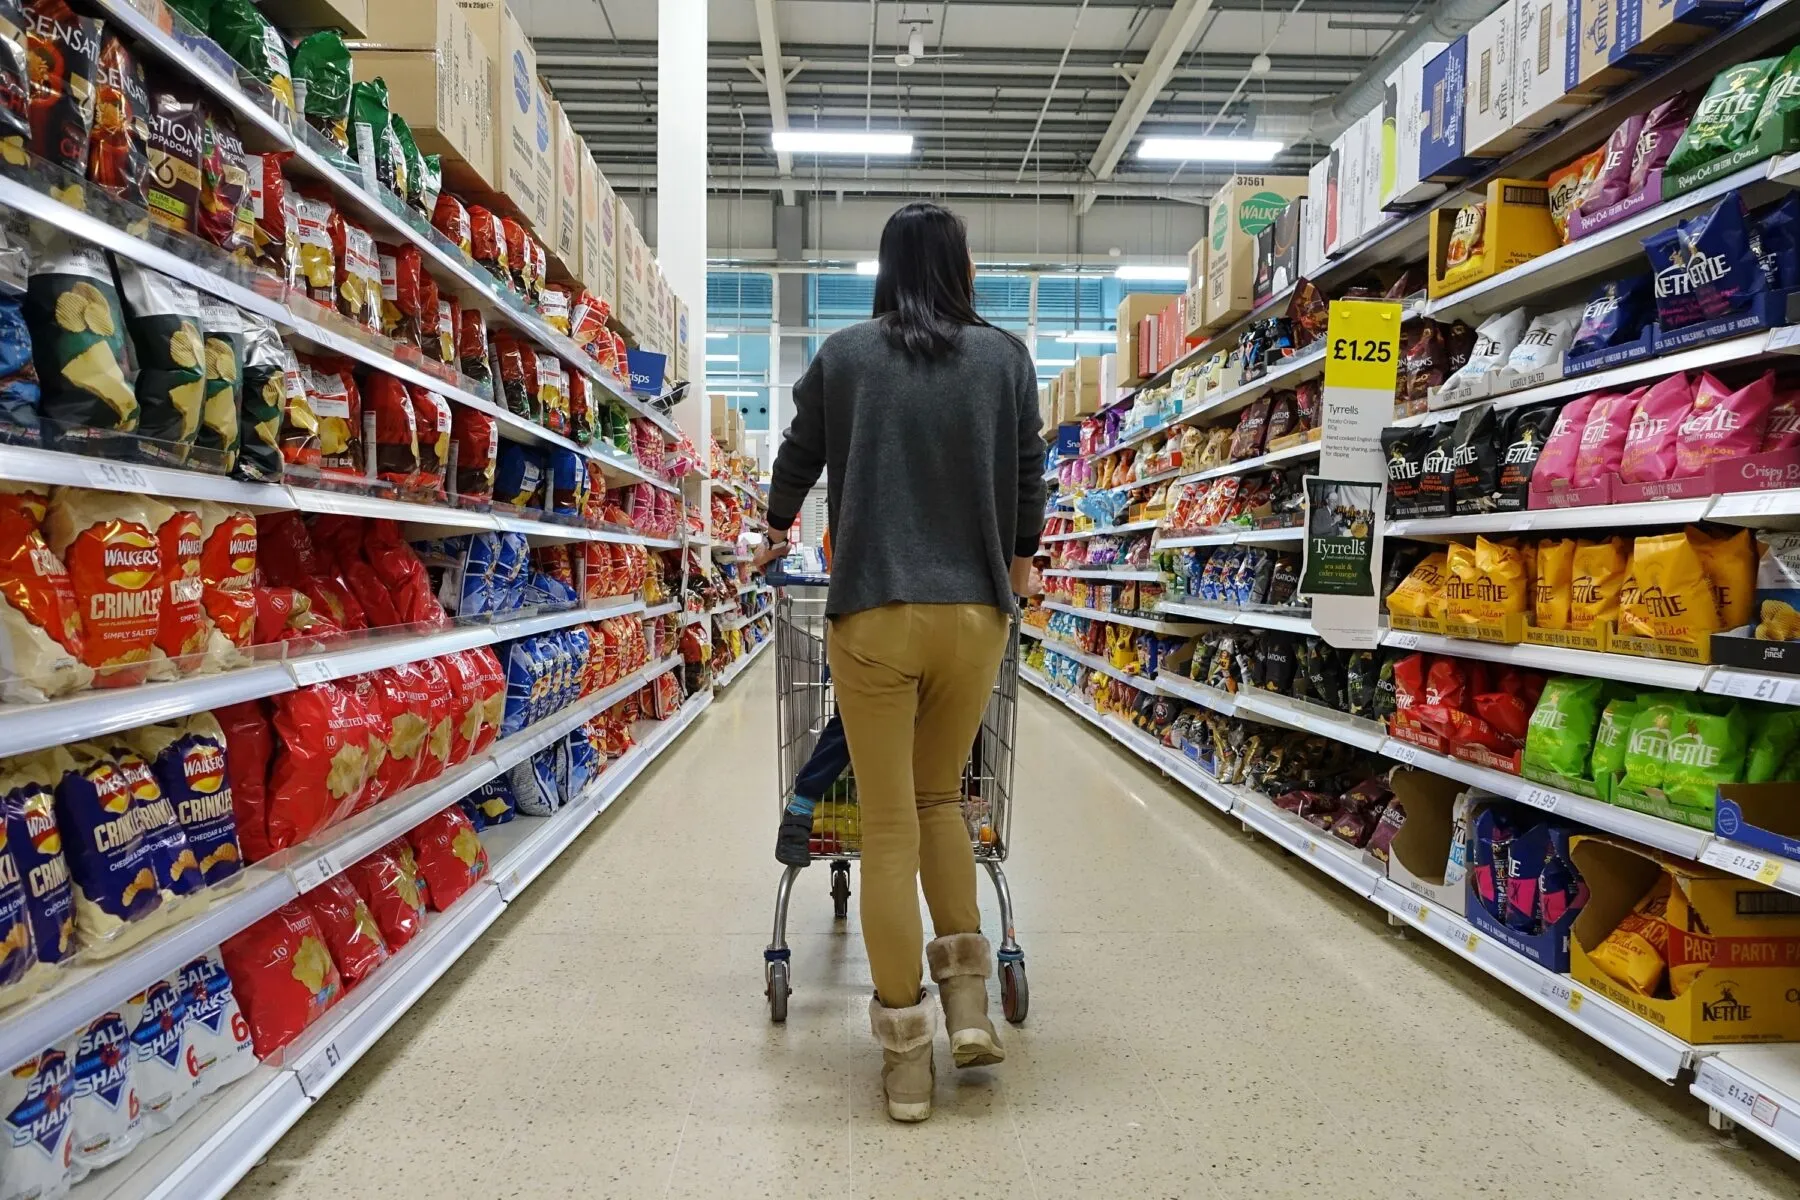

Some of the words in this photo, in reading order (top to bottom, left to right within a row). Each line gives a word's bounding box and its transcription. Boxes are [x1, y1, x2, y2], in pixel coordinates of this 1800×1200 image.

[1237, 177, 1265, 187] 37561
[1240, 205, 1280, 220] WALKE
[1333, 338, 1391, 363] £1.25
[1527, 372, 1545, 385] SALTED
[1328, 403, 1359, 416] Tyrrells
[1326, 444, 1342, 452] Perfect
[1357, 436, 1372, 444] English
[1741, 463, 1782, 482] Crispy
[105, 548, 159, 567] WALKERS
[103, 631, 130, 640] SIMPLY
[1571, 637, 1582, 645] RED
[1583, 637, 1598, 647] ONION
[1612, 639, 1631, 649] MATURE
[1665, 645, 1678, 655] RED
[1679, 646, 1699, 658] ONION
[1763, 649, 1784, 661] finest
[1754, 679, 1780, 700] £1
[184, 754, 224, 777] WALKERS
[481, 784, 494, 796] 10
[1528, 790, 1558, 809] £1.99
[179, 788, 233, 825] CRINKLES
[189, 830, 217, 843] CHEDDAR
[317, 856, 334, 878] £1
[1733, 856, 1761, 872] £1.25
[1455, 929, 1468, 943] £1.50
[273, 946, 287, 959] 10
[1731, 943, 1778, 961] PARTY
[178, 959, 219, 992] SALT
[1552, 985, 1570, 1001] £1.50
[1637, 1003, 1648, 1016] RED
[1650, 1009, 1666, 1025] ONION
[1702, 1001, 1752, 1022] KETTLE
[231, 1012, 250, 1042] 6
[79, 1020, 127, 1055] SALT
[325, 1043, 340, 1067] £1
[28, 1060, 73, 1100] SALT
[1728, 1084, 1754, 1108] £1.25
